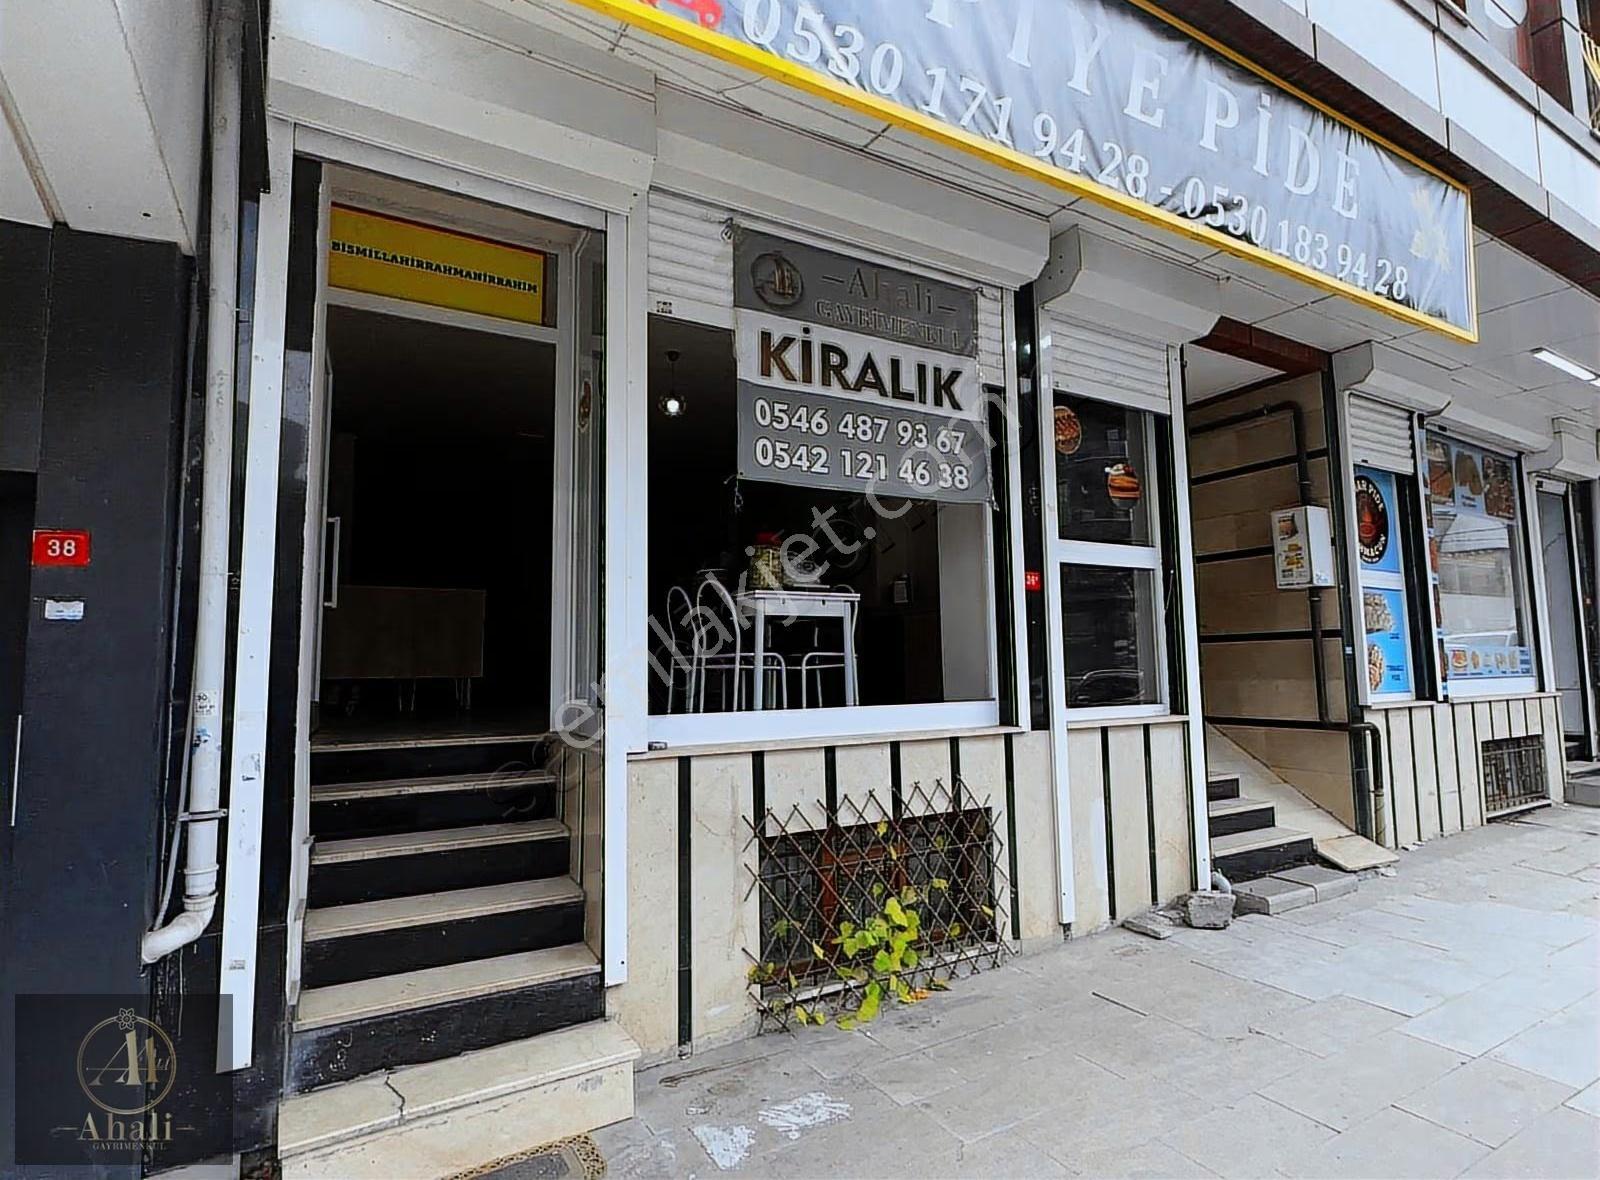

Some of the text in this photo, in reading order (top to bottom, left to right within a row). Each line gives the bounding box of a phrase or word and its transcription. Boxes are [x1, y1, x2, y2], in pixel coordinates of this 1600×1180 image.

[743, 0, 904, 94] 0530
[920, 67, 1013, 143] 171
[1033, 112, 1086, 173] 94
[1097, 141, 1149, 198] 28
[1183, 176, 1268, 246] 0530
[1276, 220, 1329, 270] 183
[1336, 244, 1369, 287] 94
[1374, 257, 1409, 300] 28
[1200, 78, 1360, 220] PİDE
[760, 327, 963, 411] KİRALIK
[754, 397, 966, 455] 0546 487 93 67
[754, 437, 970, 491] 0542 121 46 38
[48, 540, 75, 556] 38
